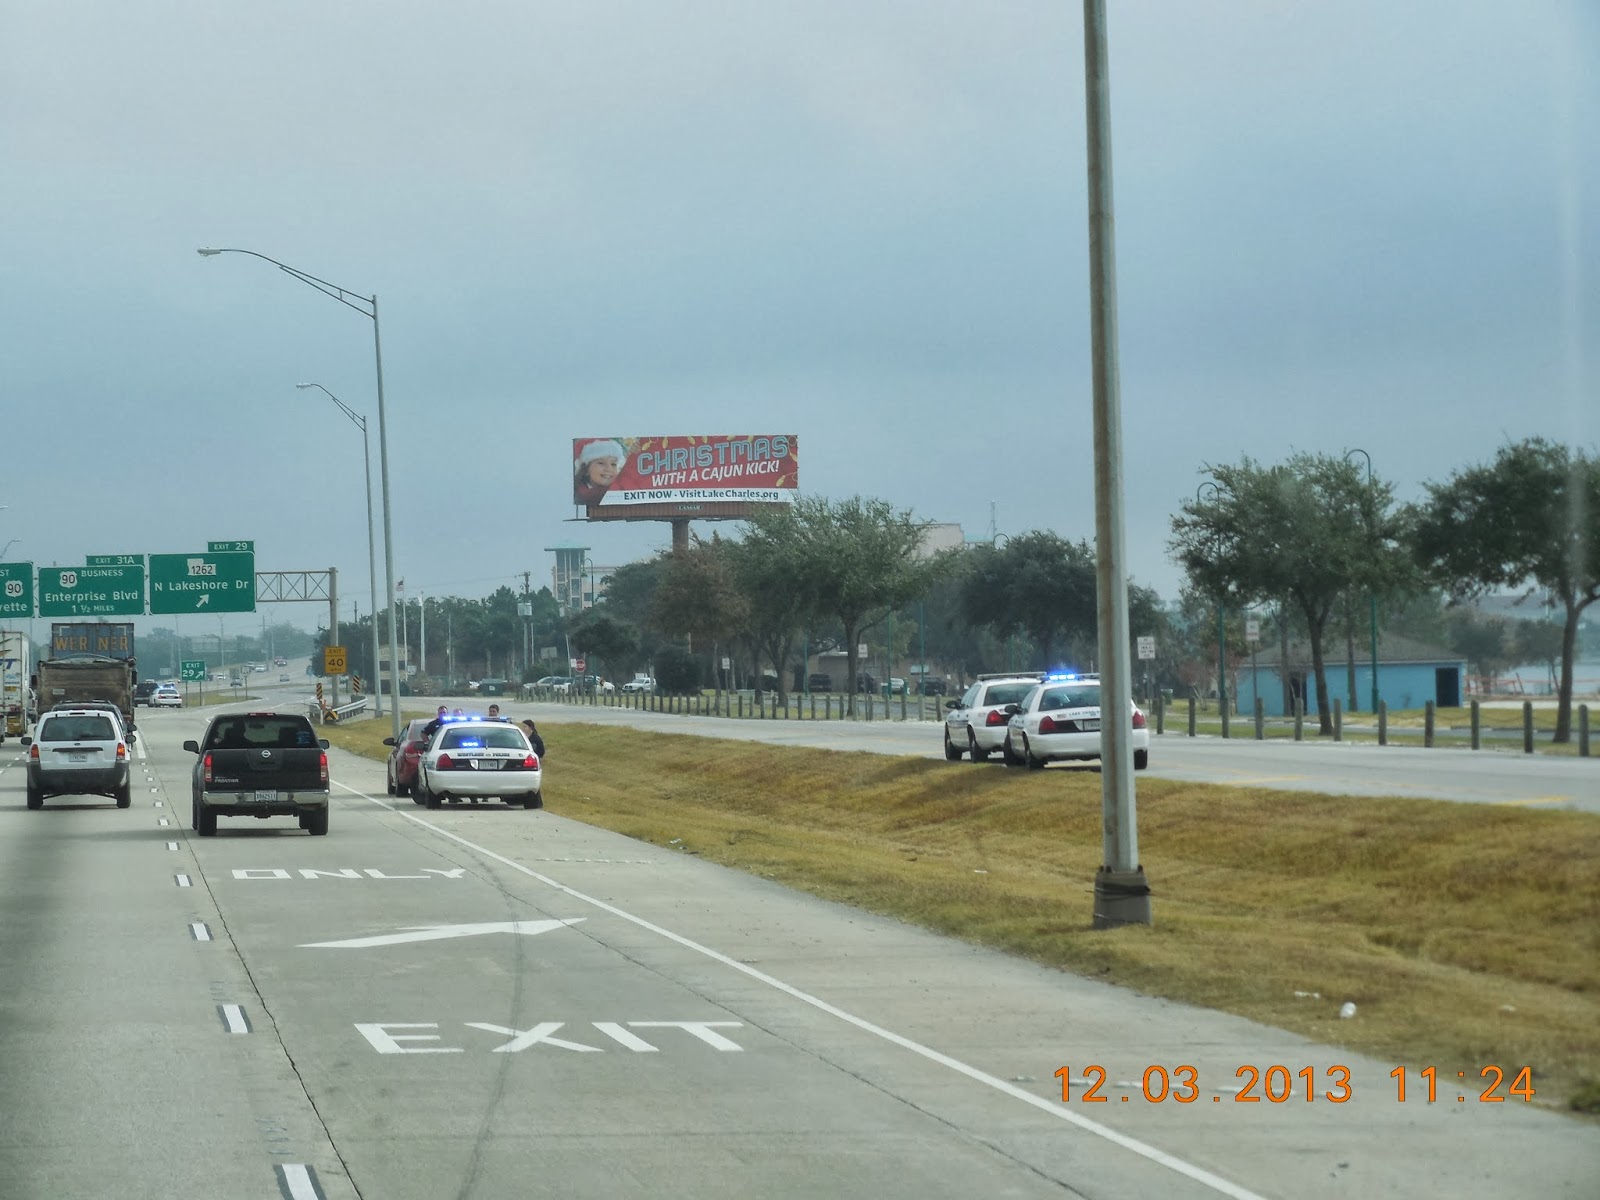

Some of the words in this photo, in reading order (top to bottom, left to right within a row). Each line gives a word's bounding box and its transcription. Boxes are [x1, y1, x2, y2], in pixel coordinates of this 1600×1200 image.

[637, 436, 788, 475] CHRISTMAS
[652, 471, 687, 487] WITH
[689, 469, 699, 482] A
[701, 464, 743, 482] CAJUN
[746, 460, 780, 475] KICK!
[624, 491, 646, 500] EXIT
[648, 490, 672, 499] NOW
[235, 542, 248, 551] 29
[117, 556, 135, 565] 31A
[191, 565, 213, 575] 1262
[61, 574, 76, 584] 90
[81, 569, 123, 577] BUSINESS
[7, 583, 21, 594] 90
[154, 582, 163, 591] N
[169, 580, 229, 591] Lakeshore
[235, 580, 249, 589] Dr
[45, 591, 107, 604] Enterprise
[112, 590, 138, 601] Blvd
[71, 605, 77, 613] 1
[328, 658, 344, 667] 40
[182, 669, 195, 677] 29
[232, 868, 467, 880] ONLY
[354, 1022, 745, 1054] EXIT
